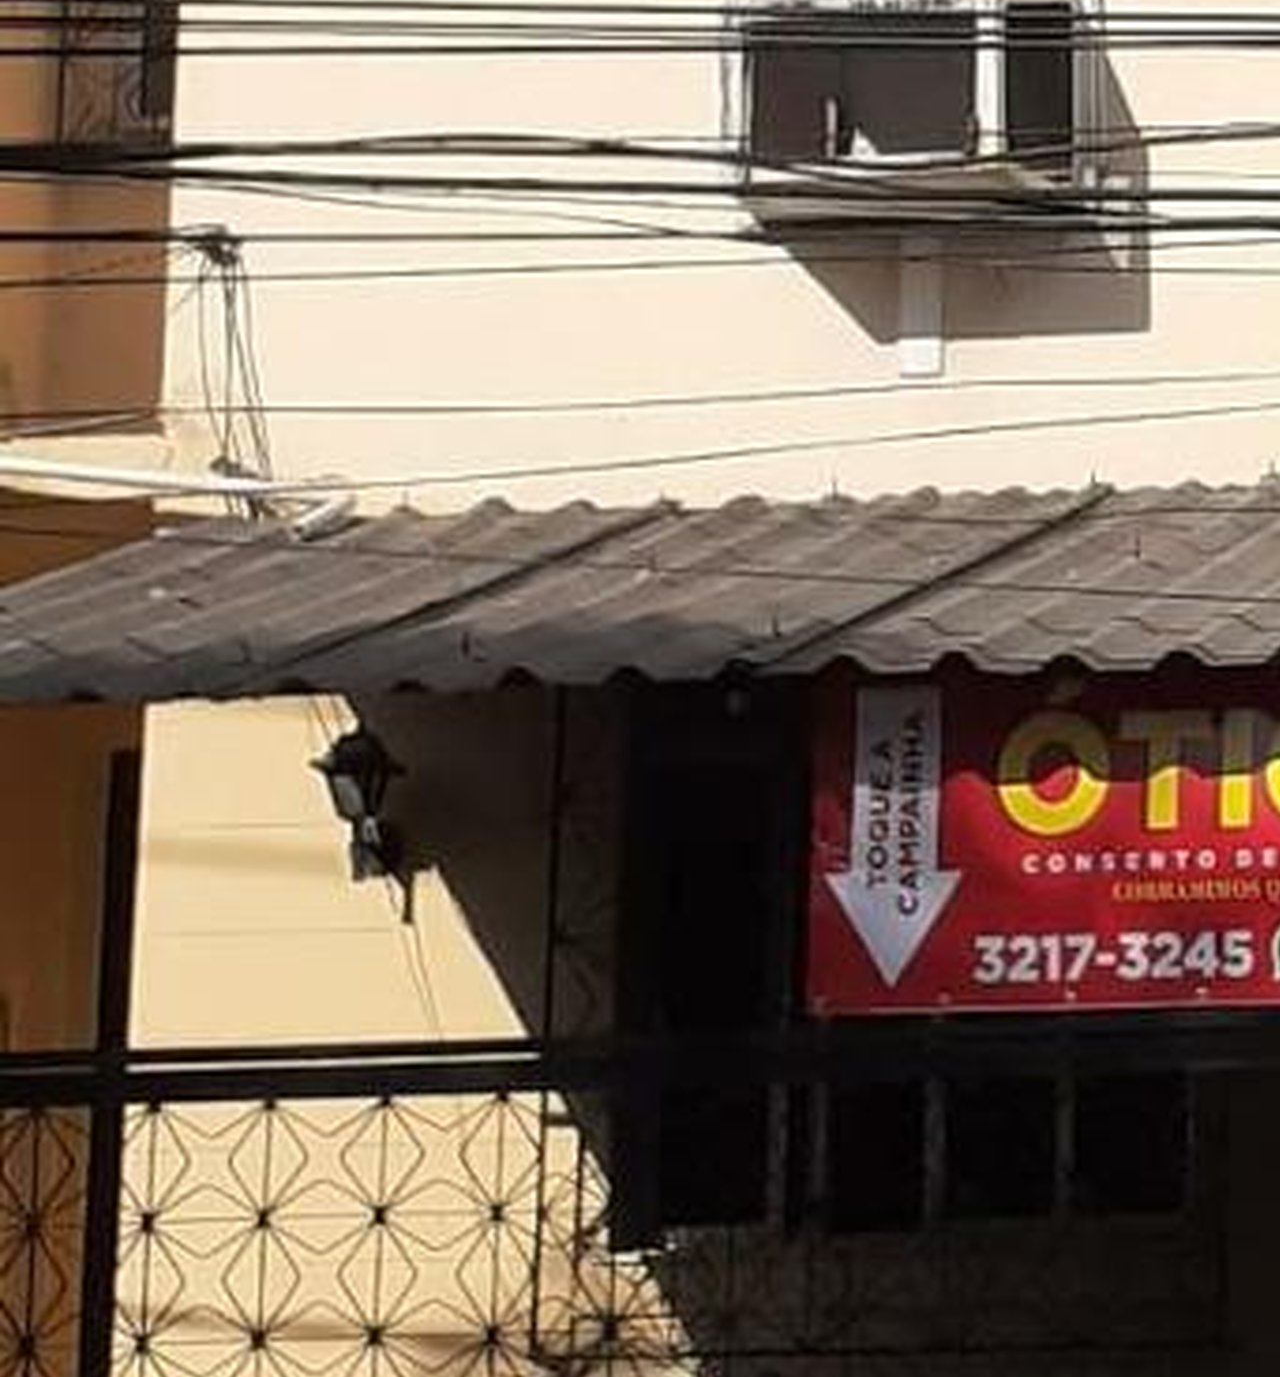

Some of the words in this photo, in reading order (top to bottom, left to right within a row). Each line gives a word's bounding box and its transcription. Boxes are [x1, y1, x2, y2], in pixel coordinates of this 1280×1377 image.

[869, 736, 895, 761] A
[867, 771, 893, 889] TOQUE
[897, 706, 926, 917] CAMPAINHA
[1021, 848, 1218, 874] CONSERTO
[1235, 847, 1278, 869] DE
[970, 930, 1254, 985] 3217-3245
